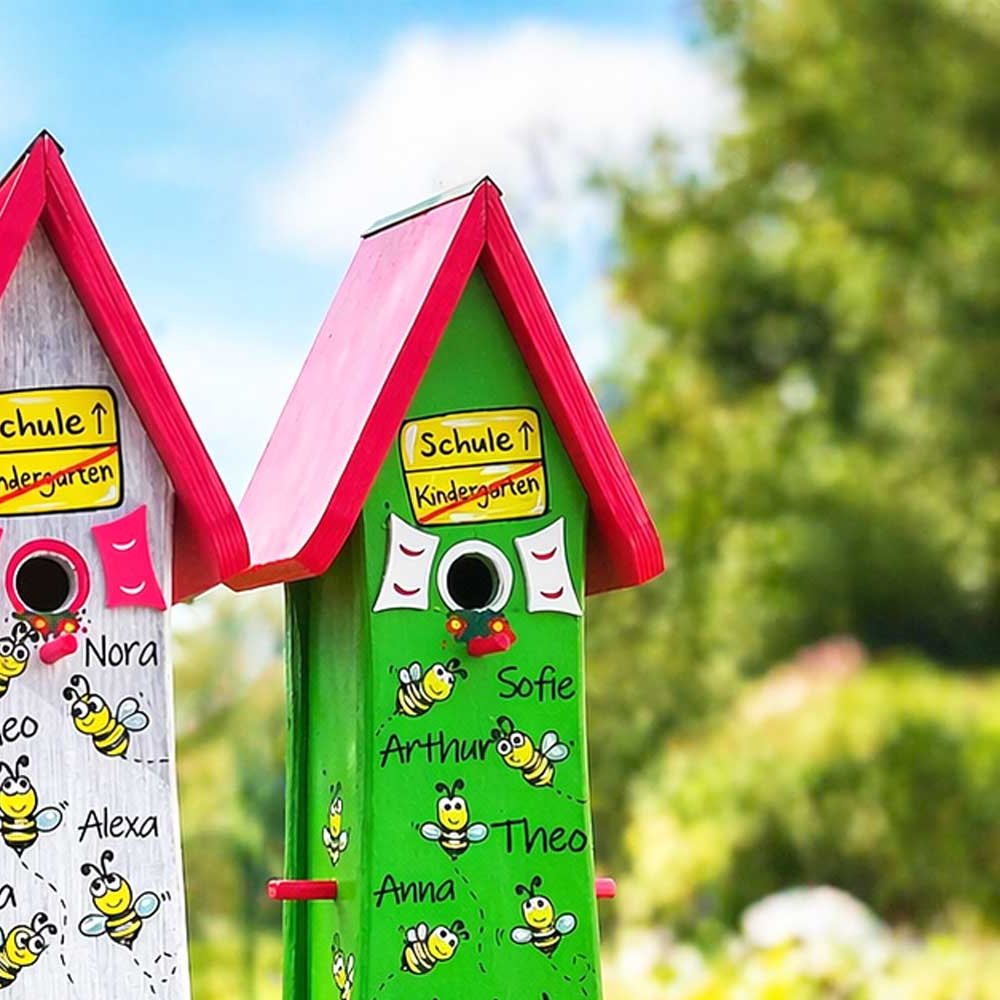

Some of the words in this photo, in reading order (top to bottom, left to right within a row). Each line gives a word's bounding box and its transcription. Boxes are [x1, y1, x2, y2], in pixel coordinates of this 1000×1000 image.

[420, 427, 514, 457] Schule
[415, 476, 540, 508] Kindergarten
[85, 635, 158, 667] Nora
[498, 665, 576, 701] Sofie
[380, 731, 493, 768] Arthur
[78, 807, 159, 842] Alexa
[491, 818, 587, 853] Theo
[373, 874, 455, 908] Anna
